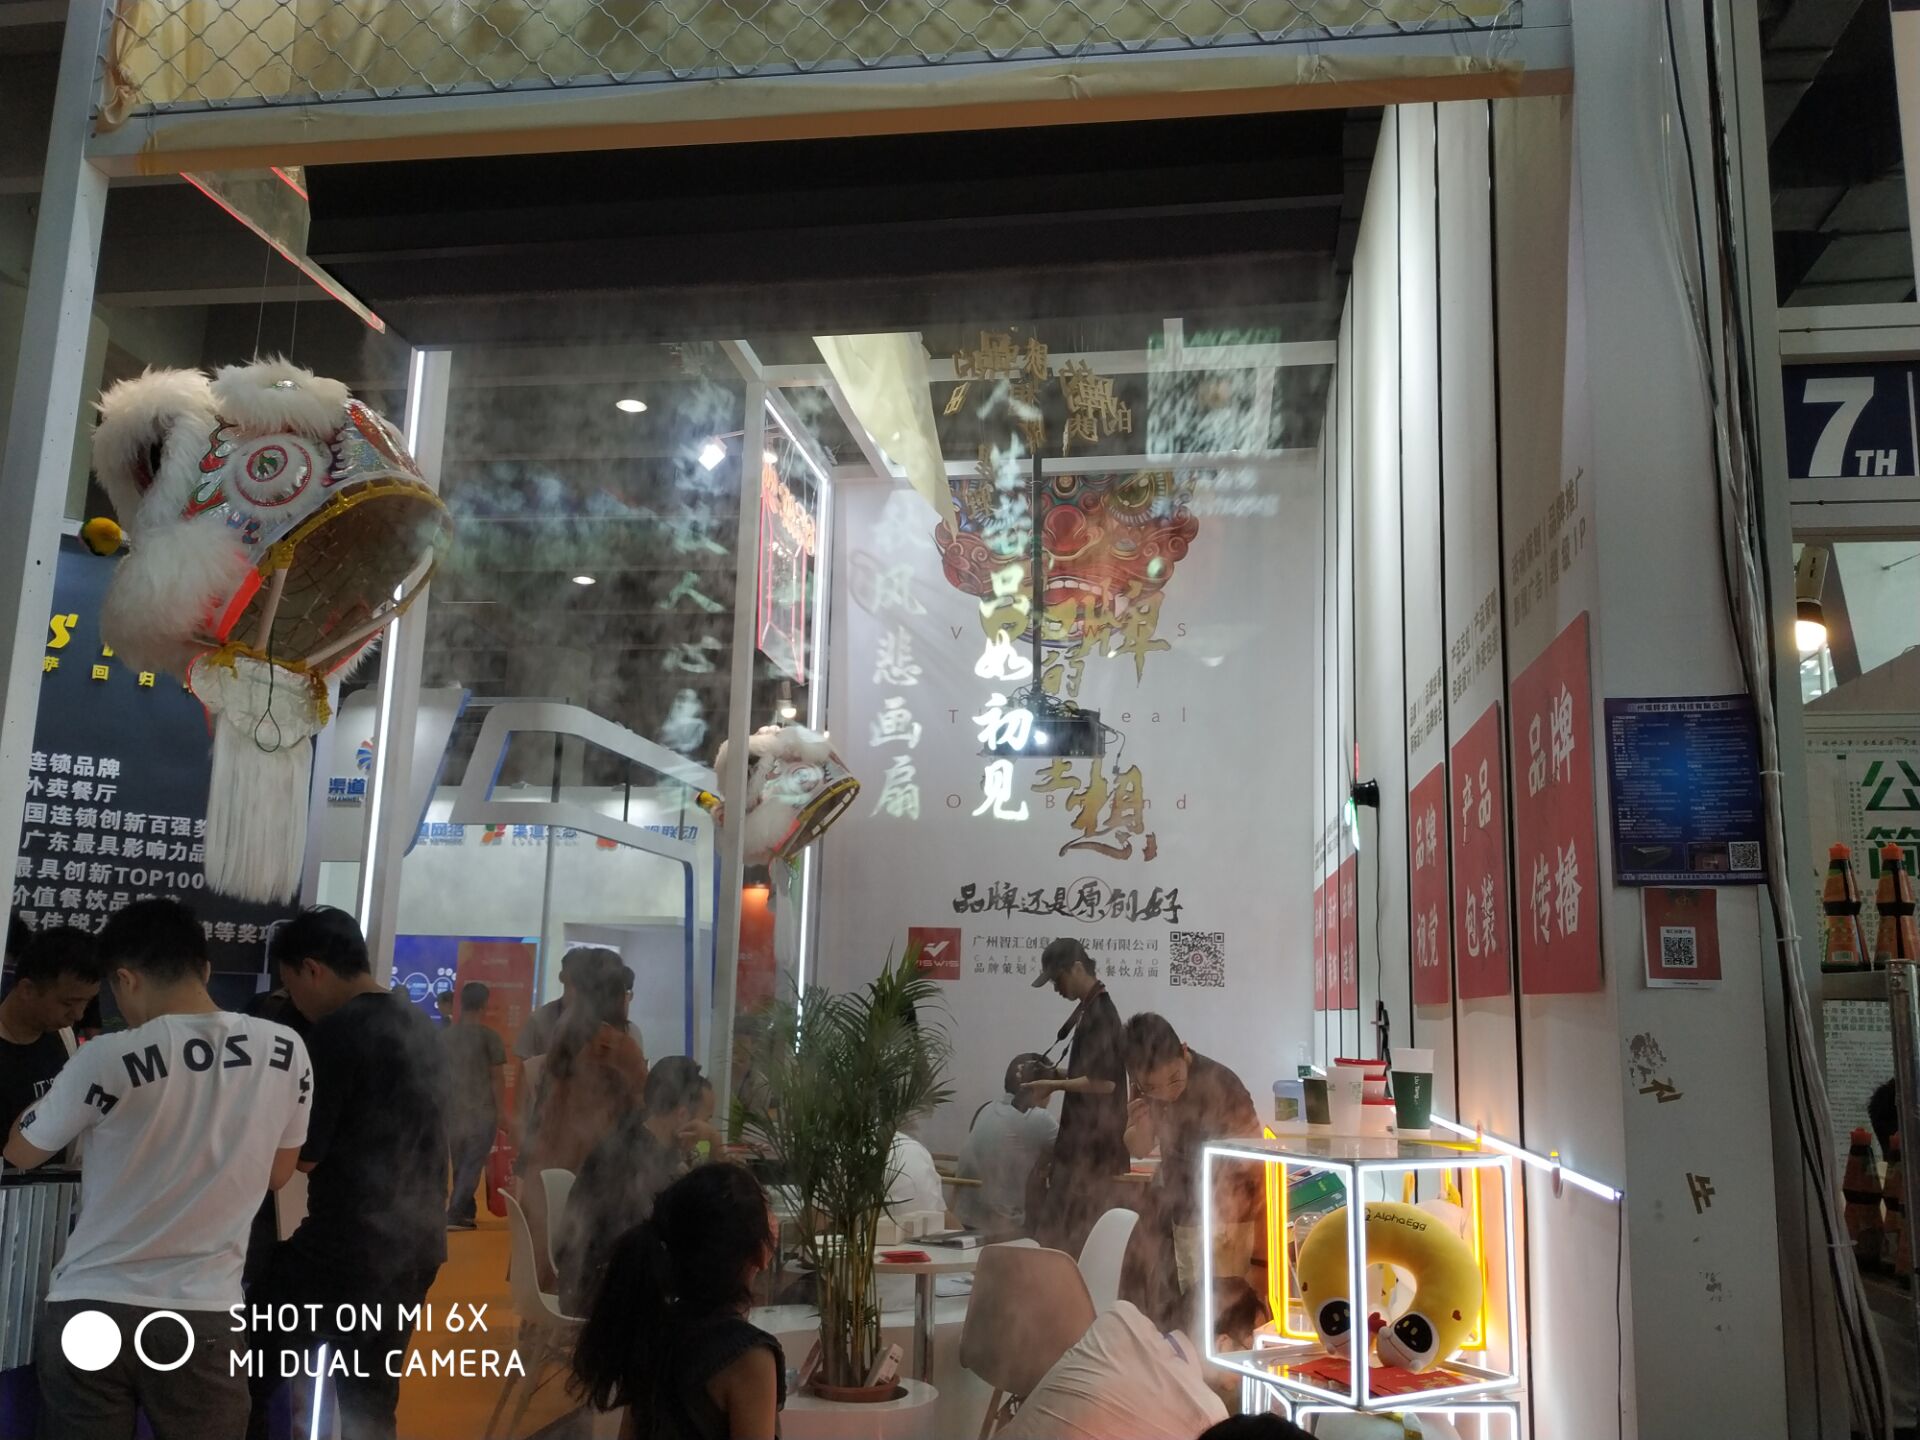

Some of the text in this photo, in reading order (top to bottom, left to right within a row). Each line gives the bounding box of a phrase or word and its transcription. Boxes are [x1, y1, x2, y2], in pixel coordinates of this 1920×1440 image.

[1802, 376, 1898, 477] 7TH
[1527, 679, 1575, 799] 品牌
[1461, 757, 1491, 847] 产品
[12, 884, 182, 912] 价值餐饮品
[953, 880, 1184, 925] 品牌还是原创好
[1529, 838, 1583, 946] 传播
